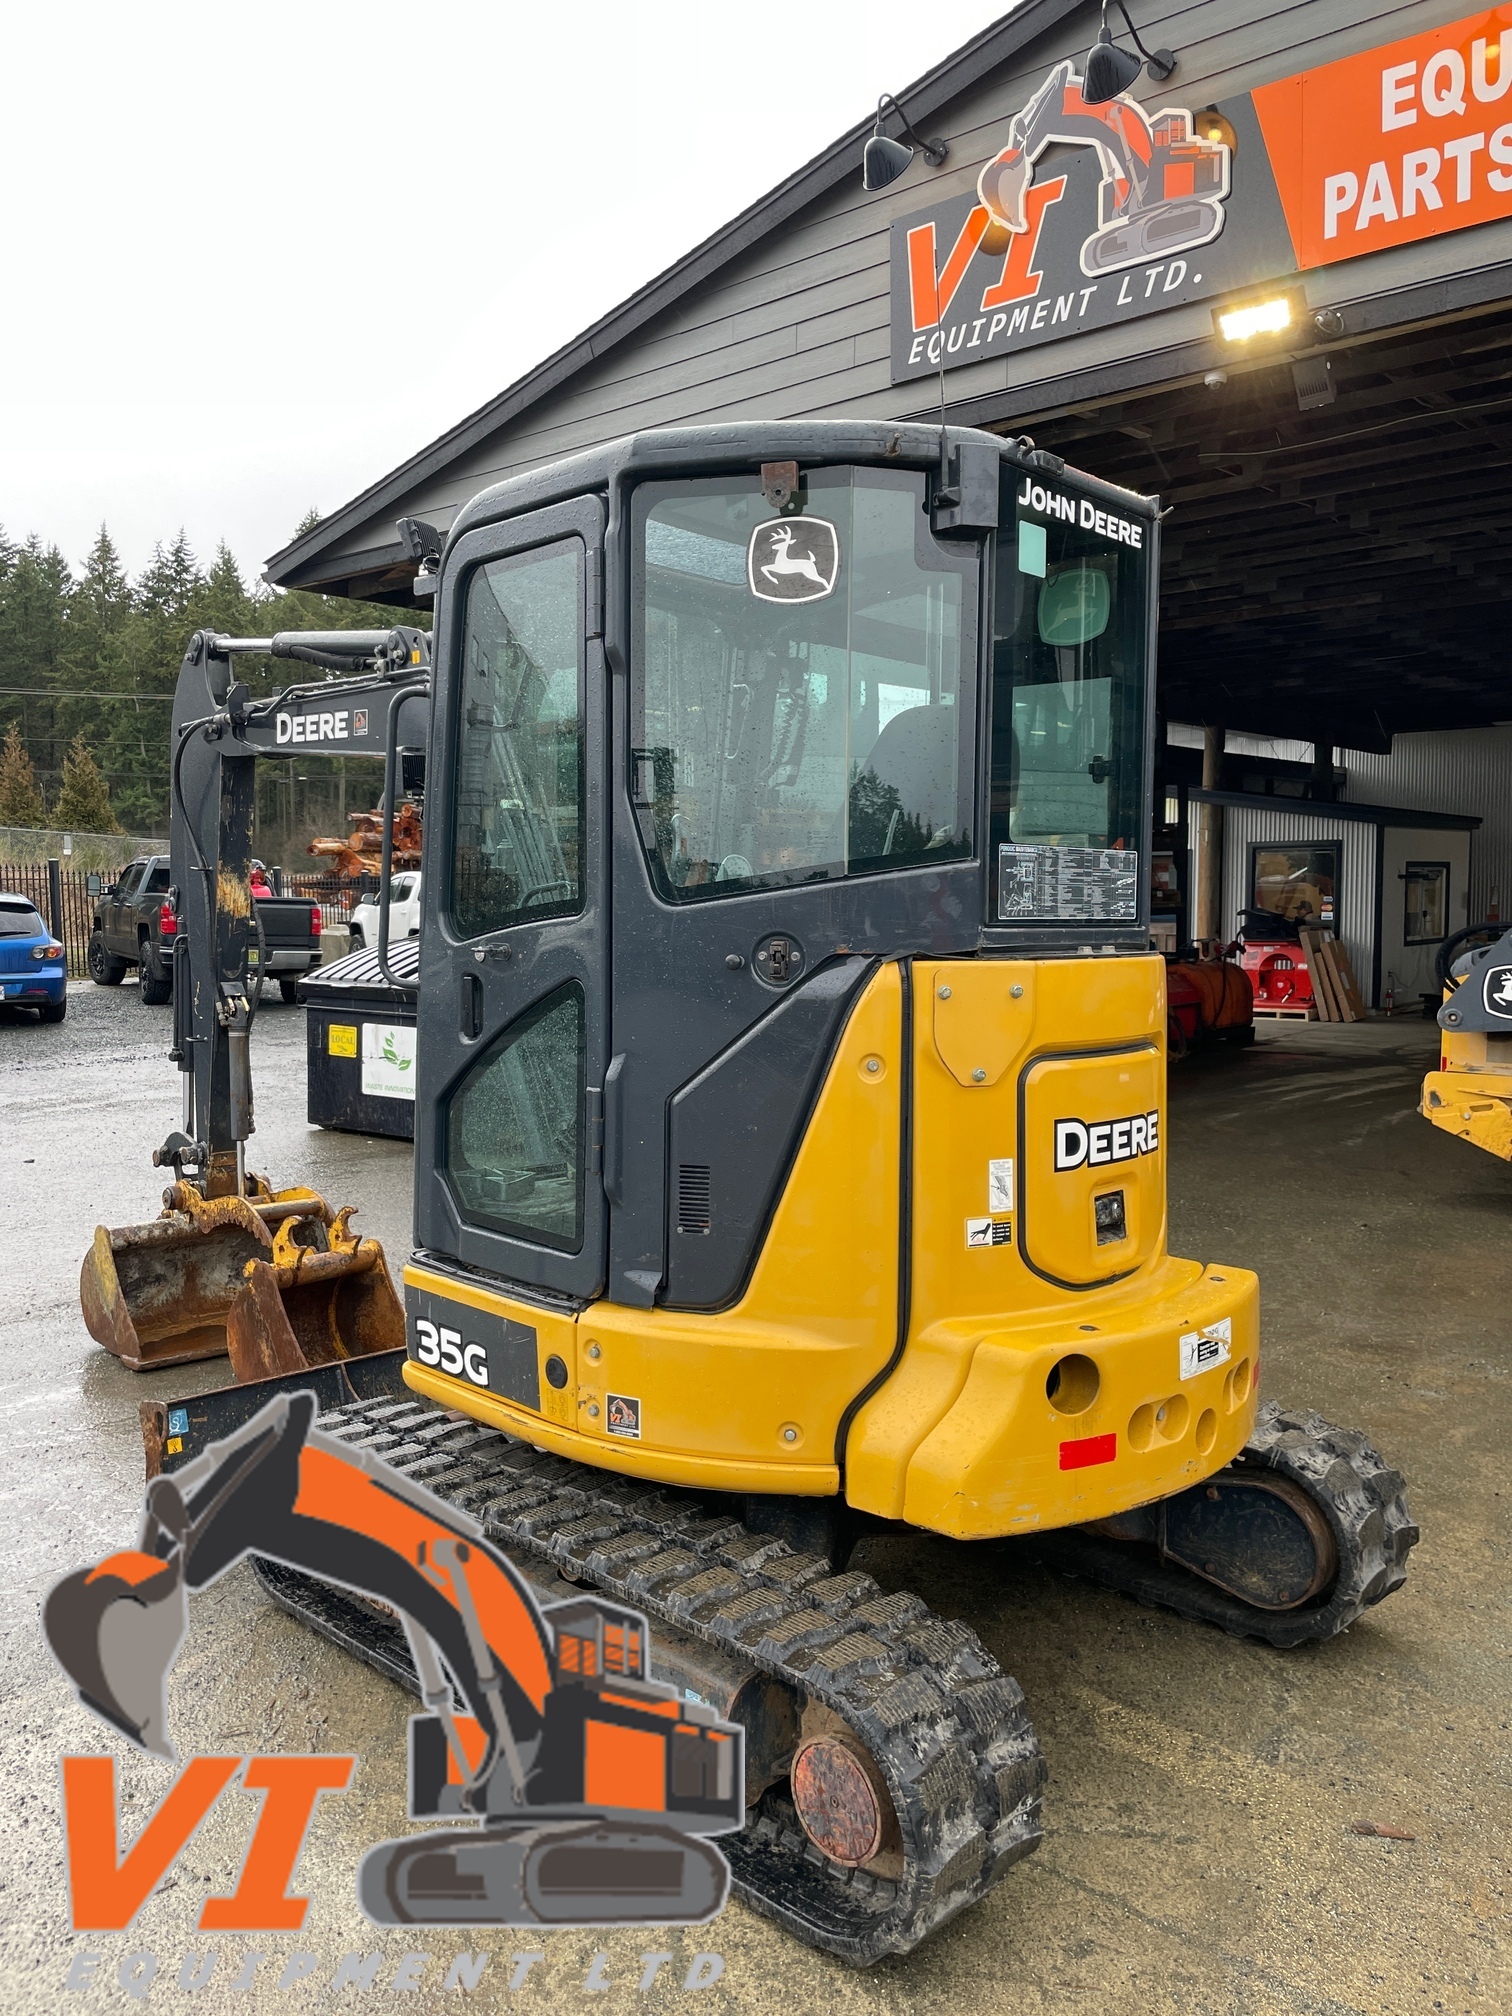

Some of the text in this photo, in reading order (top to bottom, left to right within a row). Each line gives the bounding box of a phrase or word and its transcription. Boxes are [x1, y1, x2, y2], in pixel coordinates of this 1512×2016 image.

[1382, 28, 1512, 133] EQU
[1324, 122, 1512, 240] PARTS
[906, 174, 1067, 333] VI
[908, 260, 1203, 365] EQUIPMENT LTD.
[1018, 477, 1143, 549] JOHN DEERE
[276, 711, 349, 744] DEERE
[331, 1034, 354, 1045] LOCAL
[365, 1083, 383, 1091] WASTE
[1056, 1112, 1159, 1170] DEERE
[415, 1318, 490, 1387] 35G
